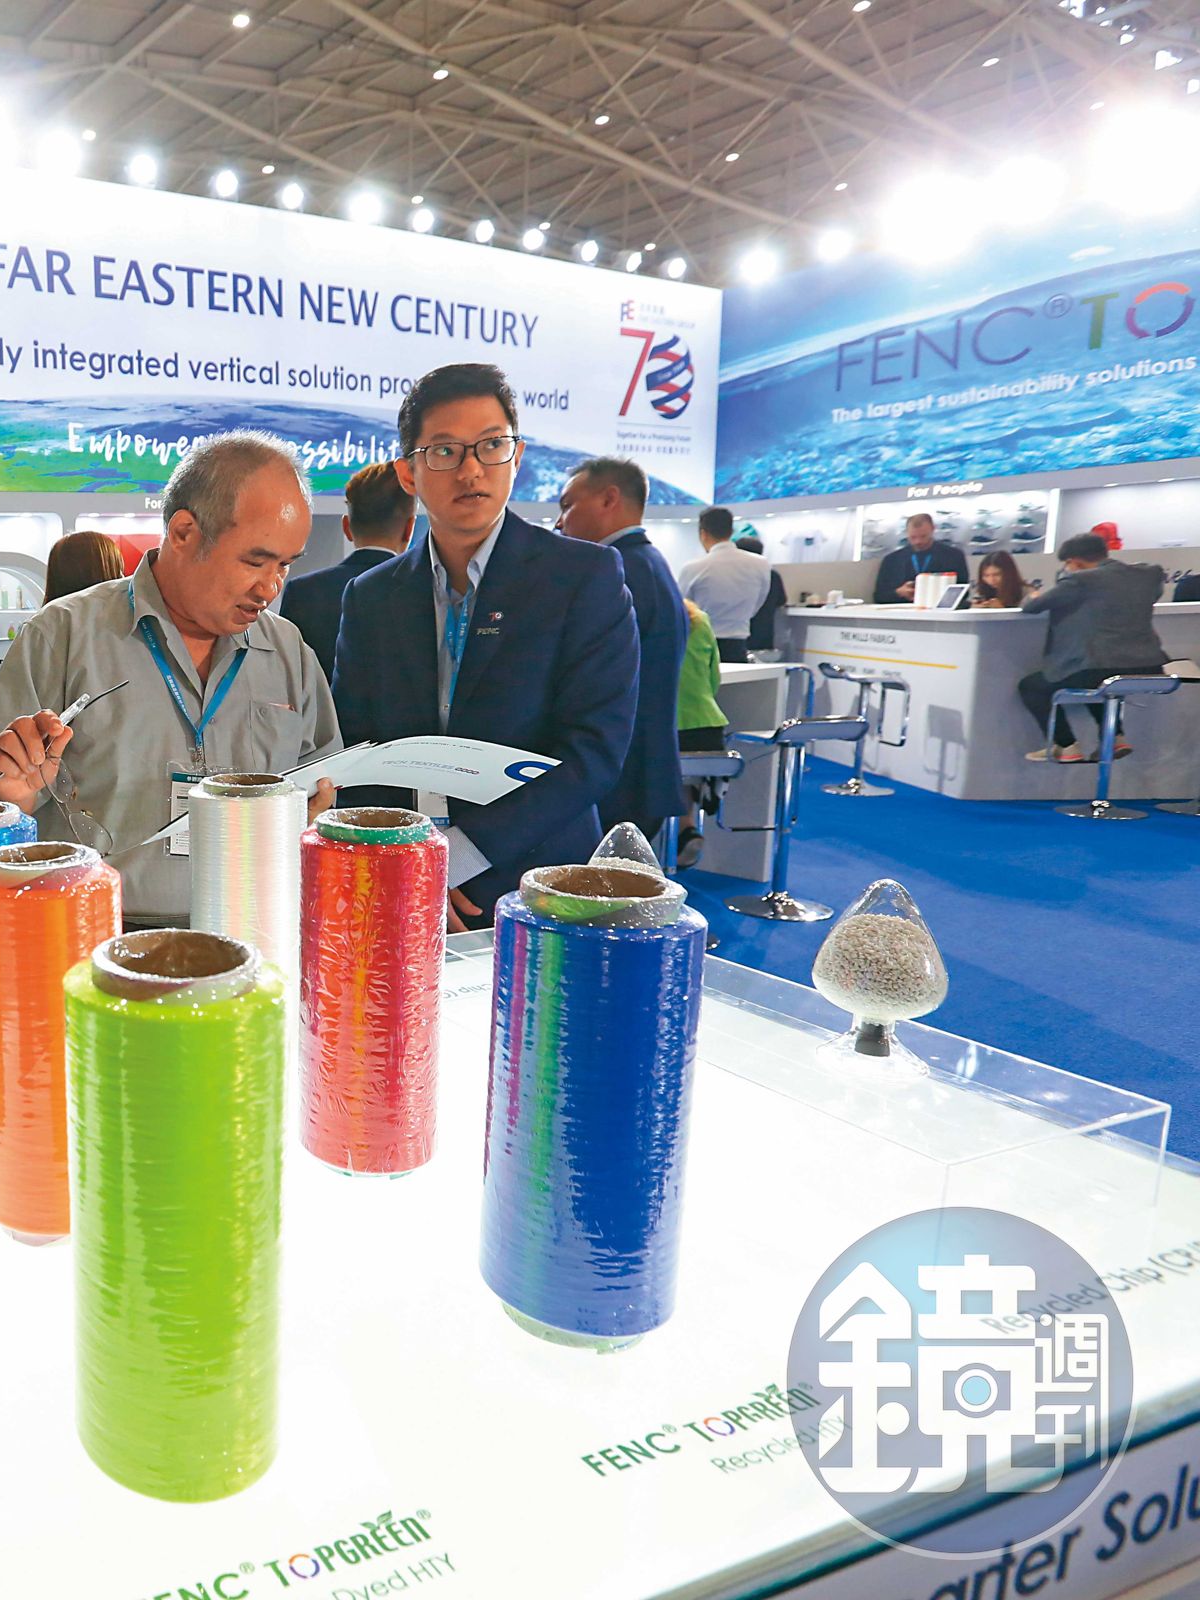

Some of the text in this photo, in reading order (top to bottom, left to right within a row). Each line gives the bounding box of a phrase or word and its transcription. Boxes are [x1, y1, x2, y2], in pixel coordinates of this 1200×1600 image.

[94, 255, 284, 318] EASTERN
[299, 281, 380, 328] NEW
[390, 294, 539, 349] CENTURY
[34, 340, 179, 379] integrated
[188, 359, 281, 386] vertical
[288, 364, 373, 393] solution
[523, 389, 570, 410] world
[832, 355, 1197, 424] The largest sustainability solutions
[286, 430, 400, 471] ossibilit
[907, 481, 983, 498] For People
[980, 1276, 1108, 1335] Recycled
[1102, 1267, 1165, 1294] Chip
[710, 1412, 853, 1475] Recycled HTY
[407, 1552, 456, 1583] HTY
